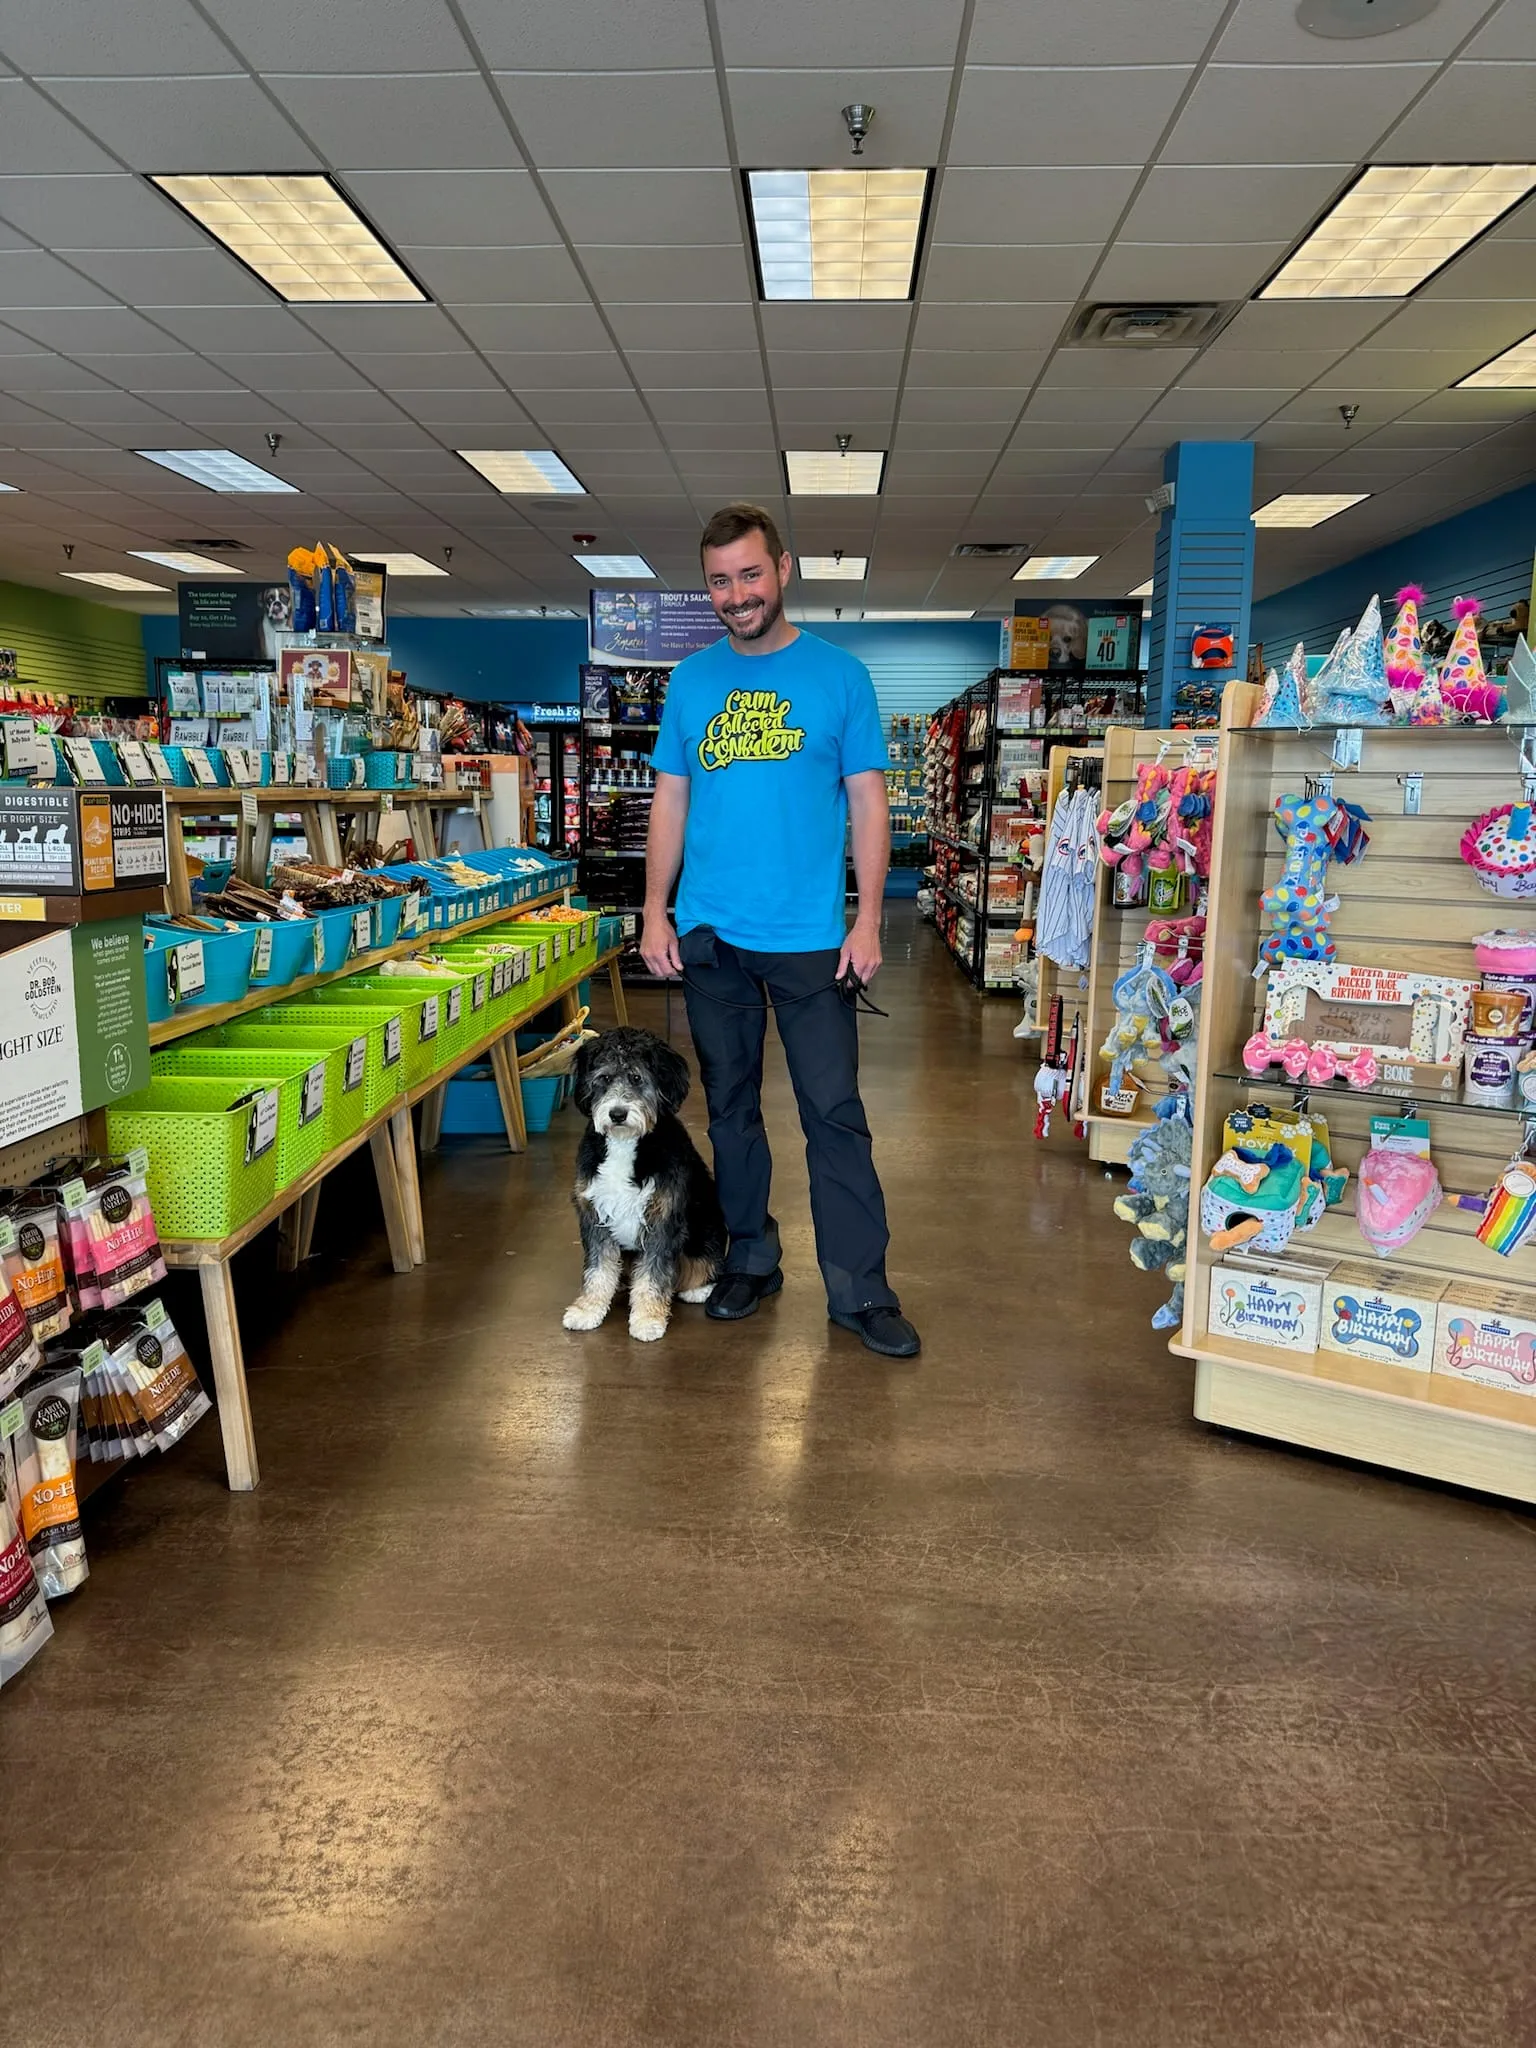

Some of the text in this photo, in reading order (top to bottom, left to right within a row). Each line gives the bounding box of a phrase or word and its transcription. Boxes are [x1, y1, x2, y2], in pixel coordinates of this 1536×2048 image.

[660, 594, 683, 602] TROUT
[684, 594, 689, 602] &
[1096, 641, 1116, 662] 40
[534, 706, 564, 716] Fresh
[706, 699, 792, 740] Collected
[5, 797, 69, 807] DIGESTIBLE
[10, 815, 36, 823] RIGHT
[113, 827, 132, 837] STRIPS
[1284, 826, 1308, 889] PARTY
[91, 934, 130, 950] We believe
[30, 976, 55, 990] DR. BOB
[1338, 977, 1398, 990] WICKED HUGE
[24, 985, 61, 1000] GOLDSTEIN
[1331, 987, 1402, 1002] BIRTHDAY TREAT
[1327, 1007, 1383, 1026] Happy
[36, 1025, 63, 1048] SIZE
[1314, 1025, 1392, 1043] Birthday
[1384, 1064, 1414, 1083] BONE
[103, 1196, 128, 1212] ANIMAL
[22, 1234, 42, 1248] ANIMAL
[1247, 1294, 1292, 1316] HAPPY
[1236, 1310, 1298, 1332] BIRTHDAY
[1356, 1309, 1403, 1331] HAPPY
[1338, 1319, 1411, 1350] BIRTHDAY
[1474, 1331, 1520, 1358] HAPPY
[1463, 1345, 1530, 1372] BIRTHDAY
[35, 1407, 69, 1428] ANIMAL
[38, 1400, 63, 1418] EARTH
[41, 1524, 66, 1540] EASILY
